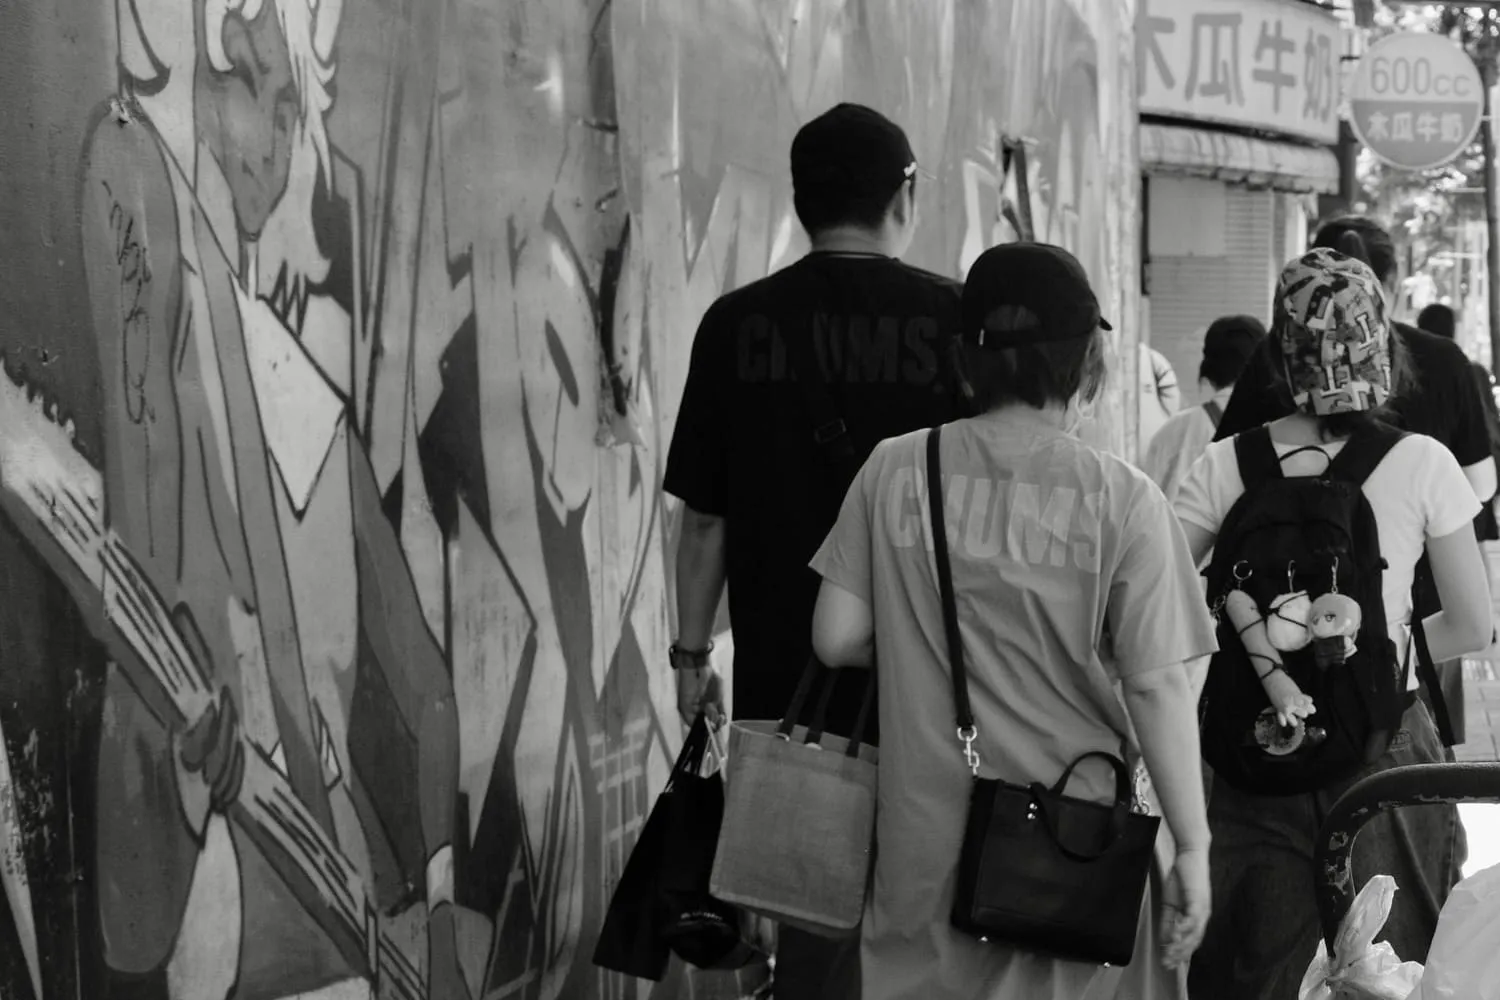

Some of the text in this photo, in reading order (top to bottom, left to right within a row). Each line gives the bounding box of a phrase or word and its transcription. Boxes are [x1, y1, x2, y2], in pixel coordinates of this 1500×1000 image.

[1370, 56, 1471, 97] 600cc
[1366, 111, 1464, 144] 木瓜牛奶
